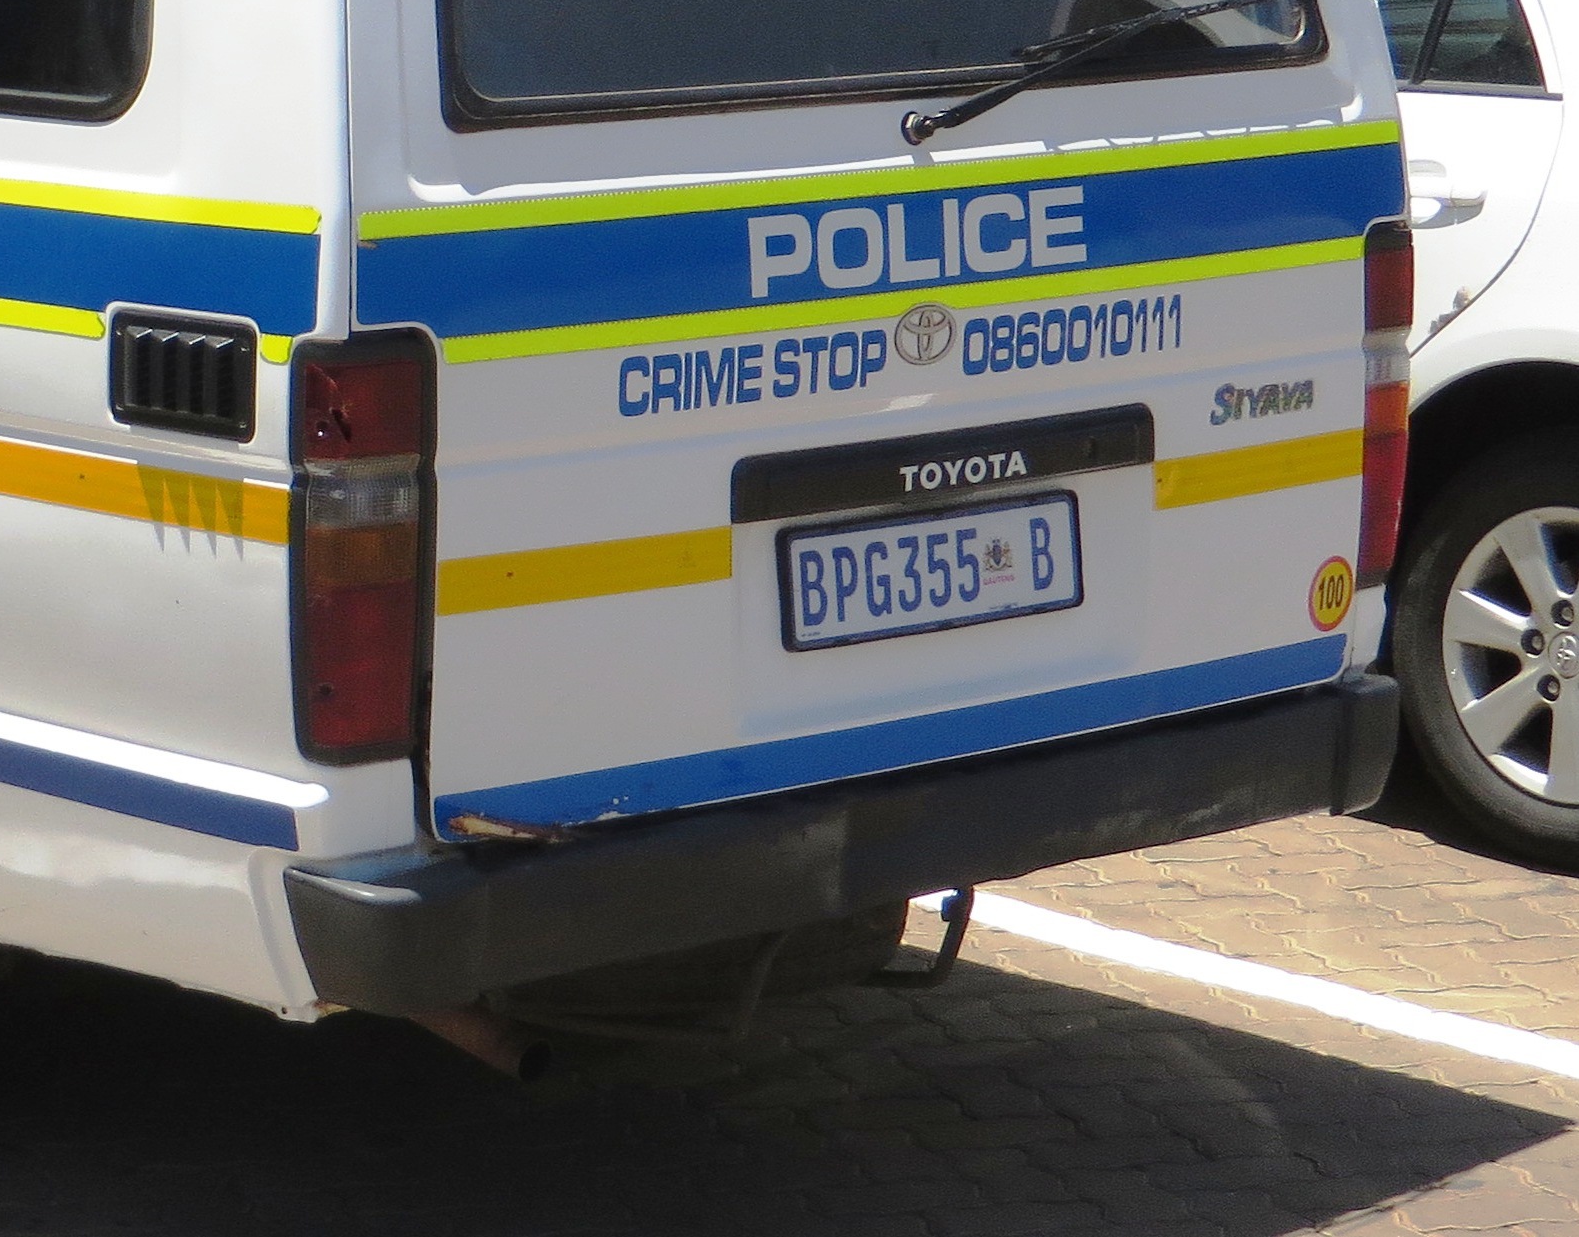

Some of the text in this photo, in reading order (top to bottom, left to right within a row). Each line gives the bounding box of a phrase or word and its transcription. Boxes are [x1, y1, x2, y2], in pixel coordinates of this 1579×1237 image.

[748, 185, 1087, 298] POLICE
[619, 294, 1182, 417] CRIME STOP 0860010111
[899, 451, 1027, 492] TOYOTA
[799, 517, 1054, 627] BPG355 B
[1319, 573, 1344, 610] 100
